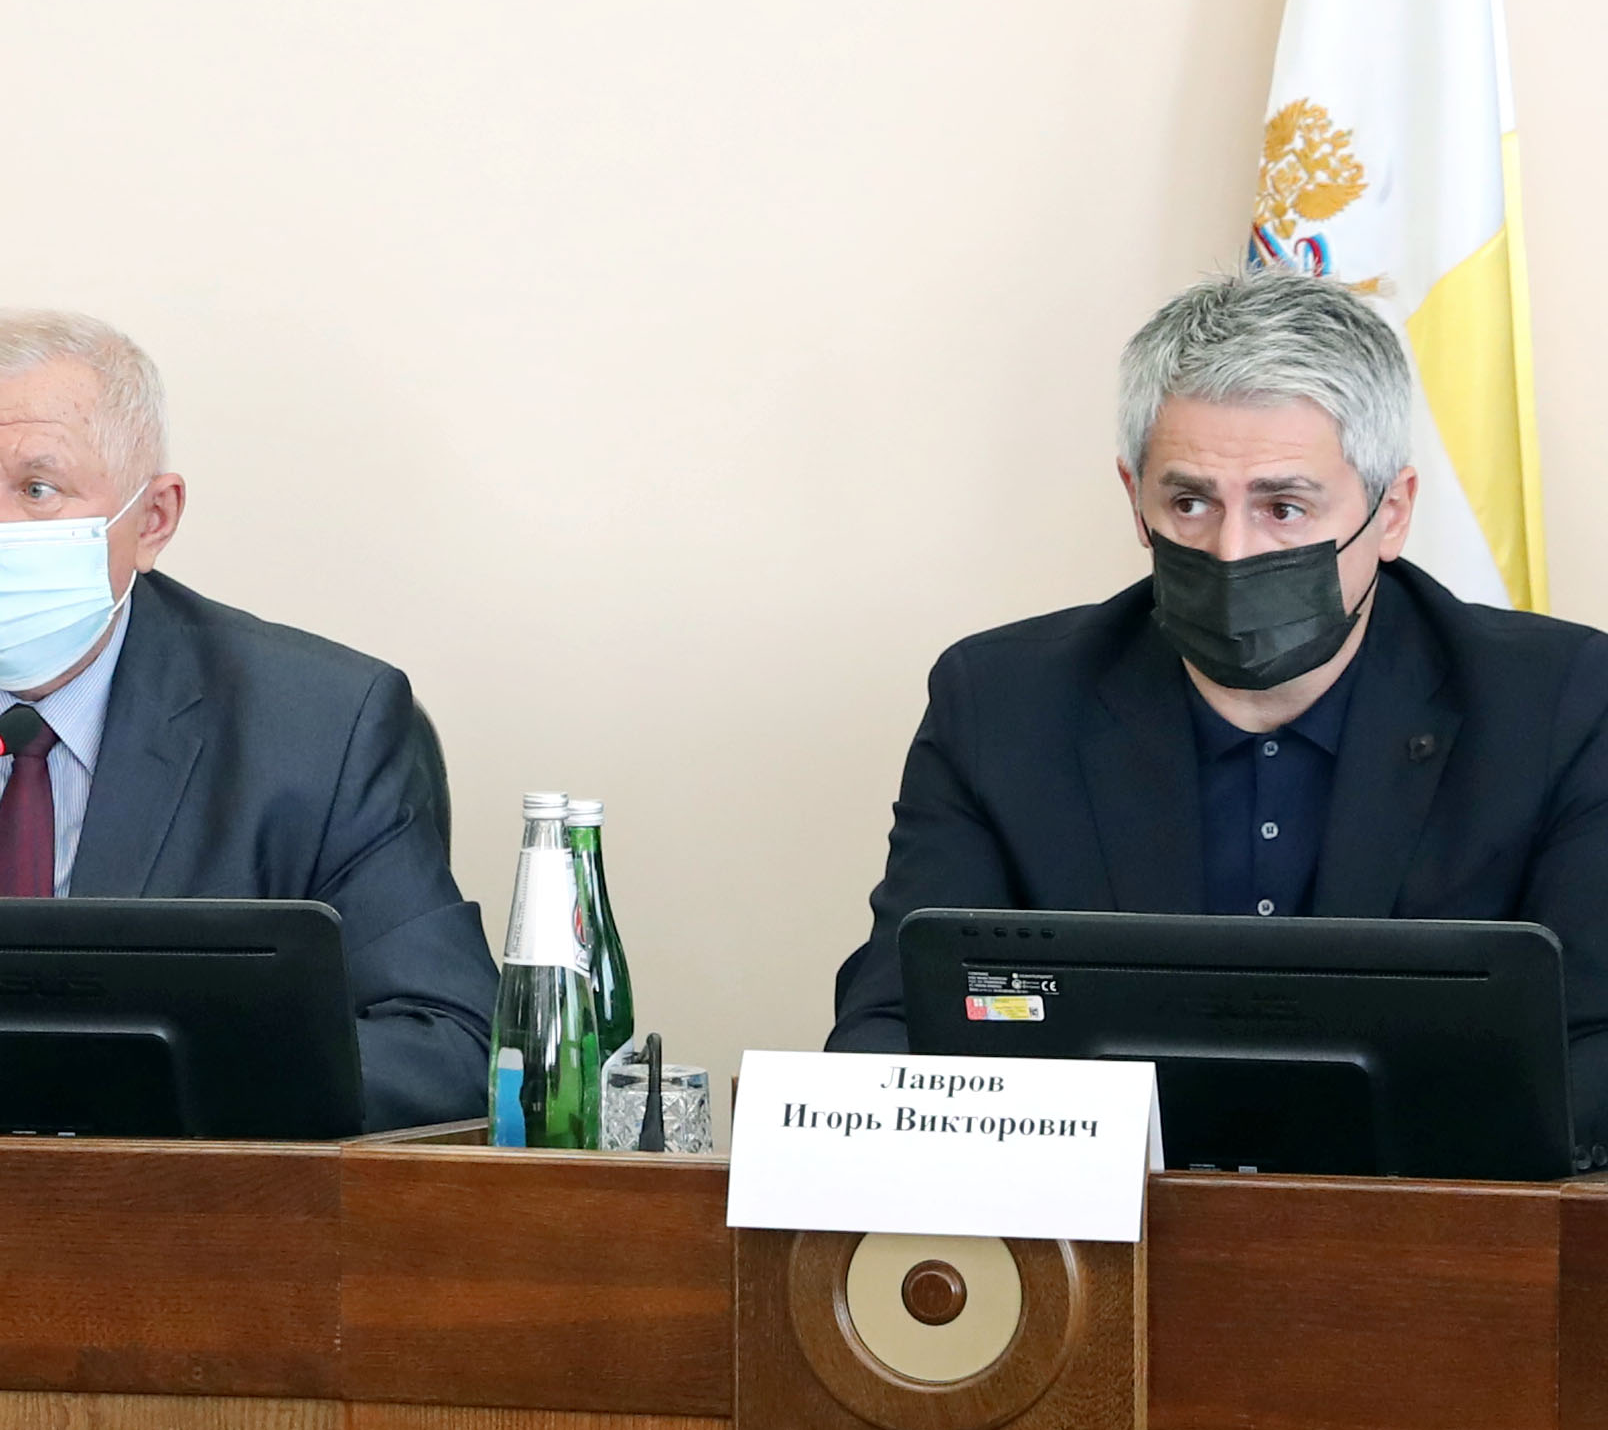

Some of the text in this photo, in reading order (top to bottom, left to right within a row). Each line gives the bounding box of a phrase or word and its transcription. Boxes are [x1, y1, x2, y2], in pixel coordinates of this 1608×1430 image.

[880, 1066, 1005, 1098] Лавров
[783, 1103, 1099, 1142] Игорь Викторович
